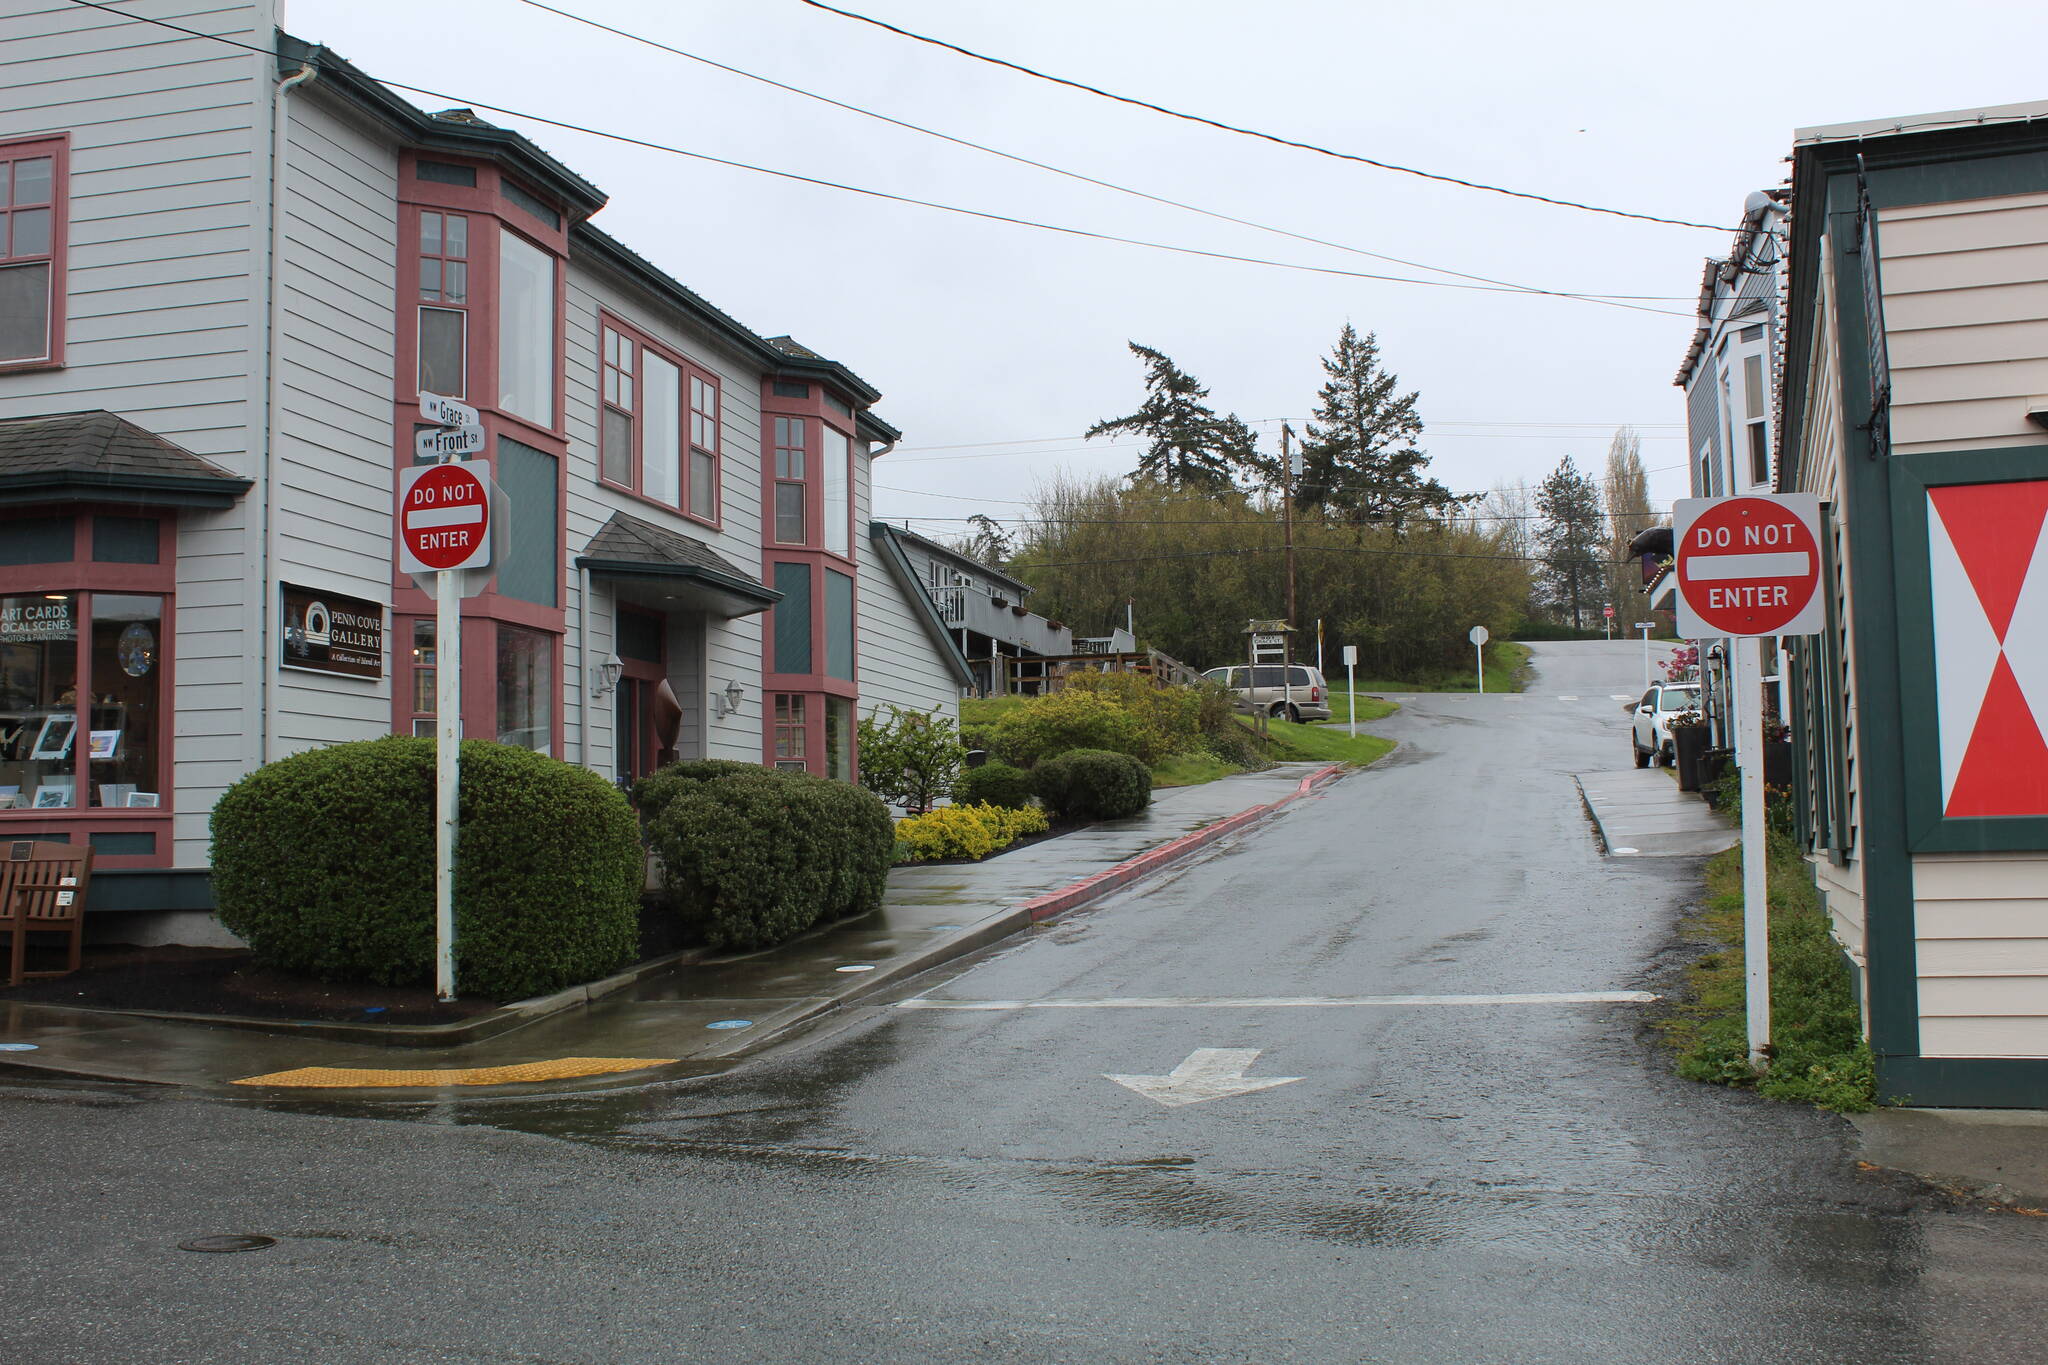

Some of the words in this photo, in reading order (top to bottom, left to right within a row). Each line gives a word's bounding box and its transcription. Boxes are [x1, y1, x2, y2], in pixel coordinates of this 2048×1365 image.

[430, 401, 437, 411] NW
[440, 401, 462, 425] Grace
[423, 438, 433, 448] NW
[435, 431, 468, 451] Front
[470, 433, 478, 443] St
[414, 487, 435, 504] DO
[442, 483, 475, 502] NOT
[420, 530, 469, 550] ENTER
[1697, 526, 1731, 548] DO
[1744, 523, 1796, 546] NOT
[1709, 585, 1789, 609] ENTER
[1, 607, 22, 621] ART
[25, 605, 68, 619] CARDS
[331, 611, 356, 626] PENN
[357, 616, 380, 630] COVE
[0, 622, 31, 632] OCAL
[33, 620, 71, 631] SCENES
[33, 632, 68, 640] PAINTINGS
[331, 629, 380, 648] GALLERY
[331, 653, 336, 661] A
[336, 653, 356, 663] Collection
[373, 659, 381, 667] Art
